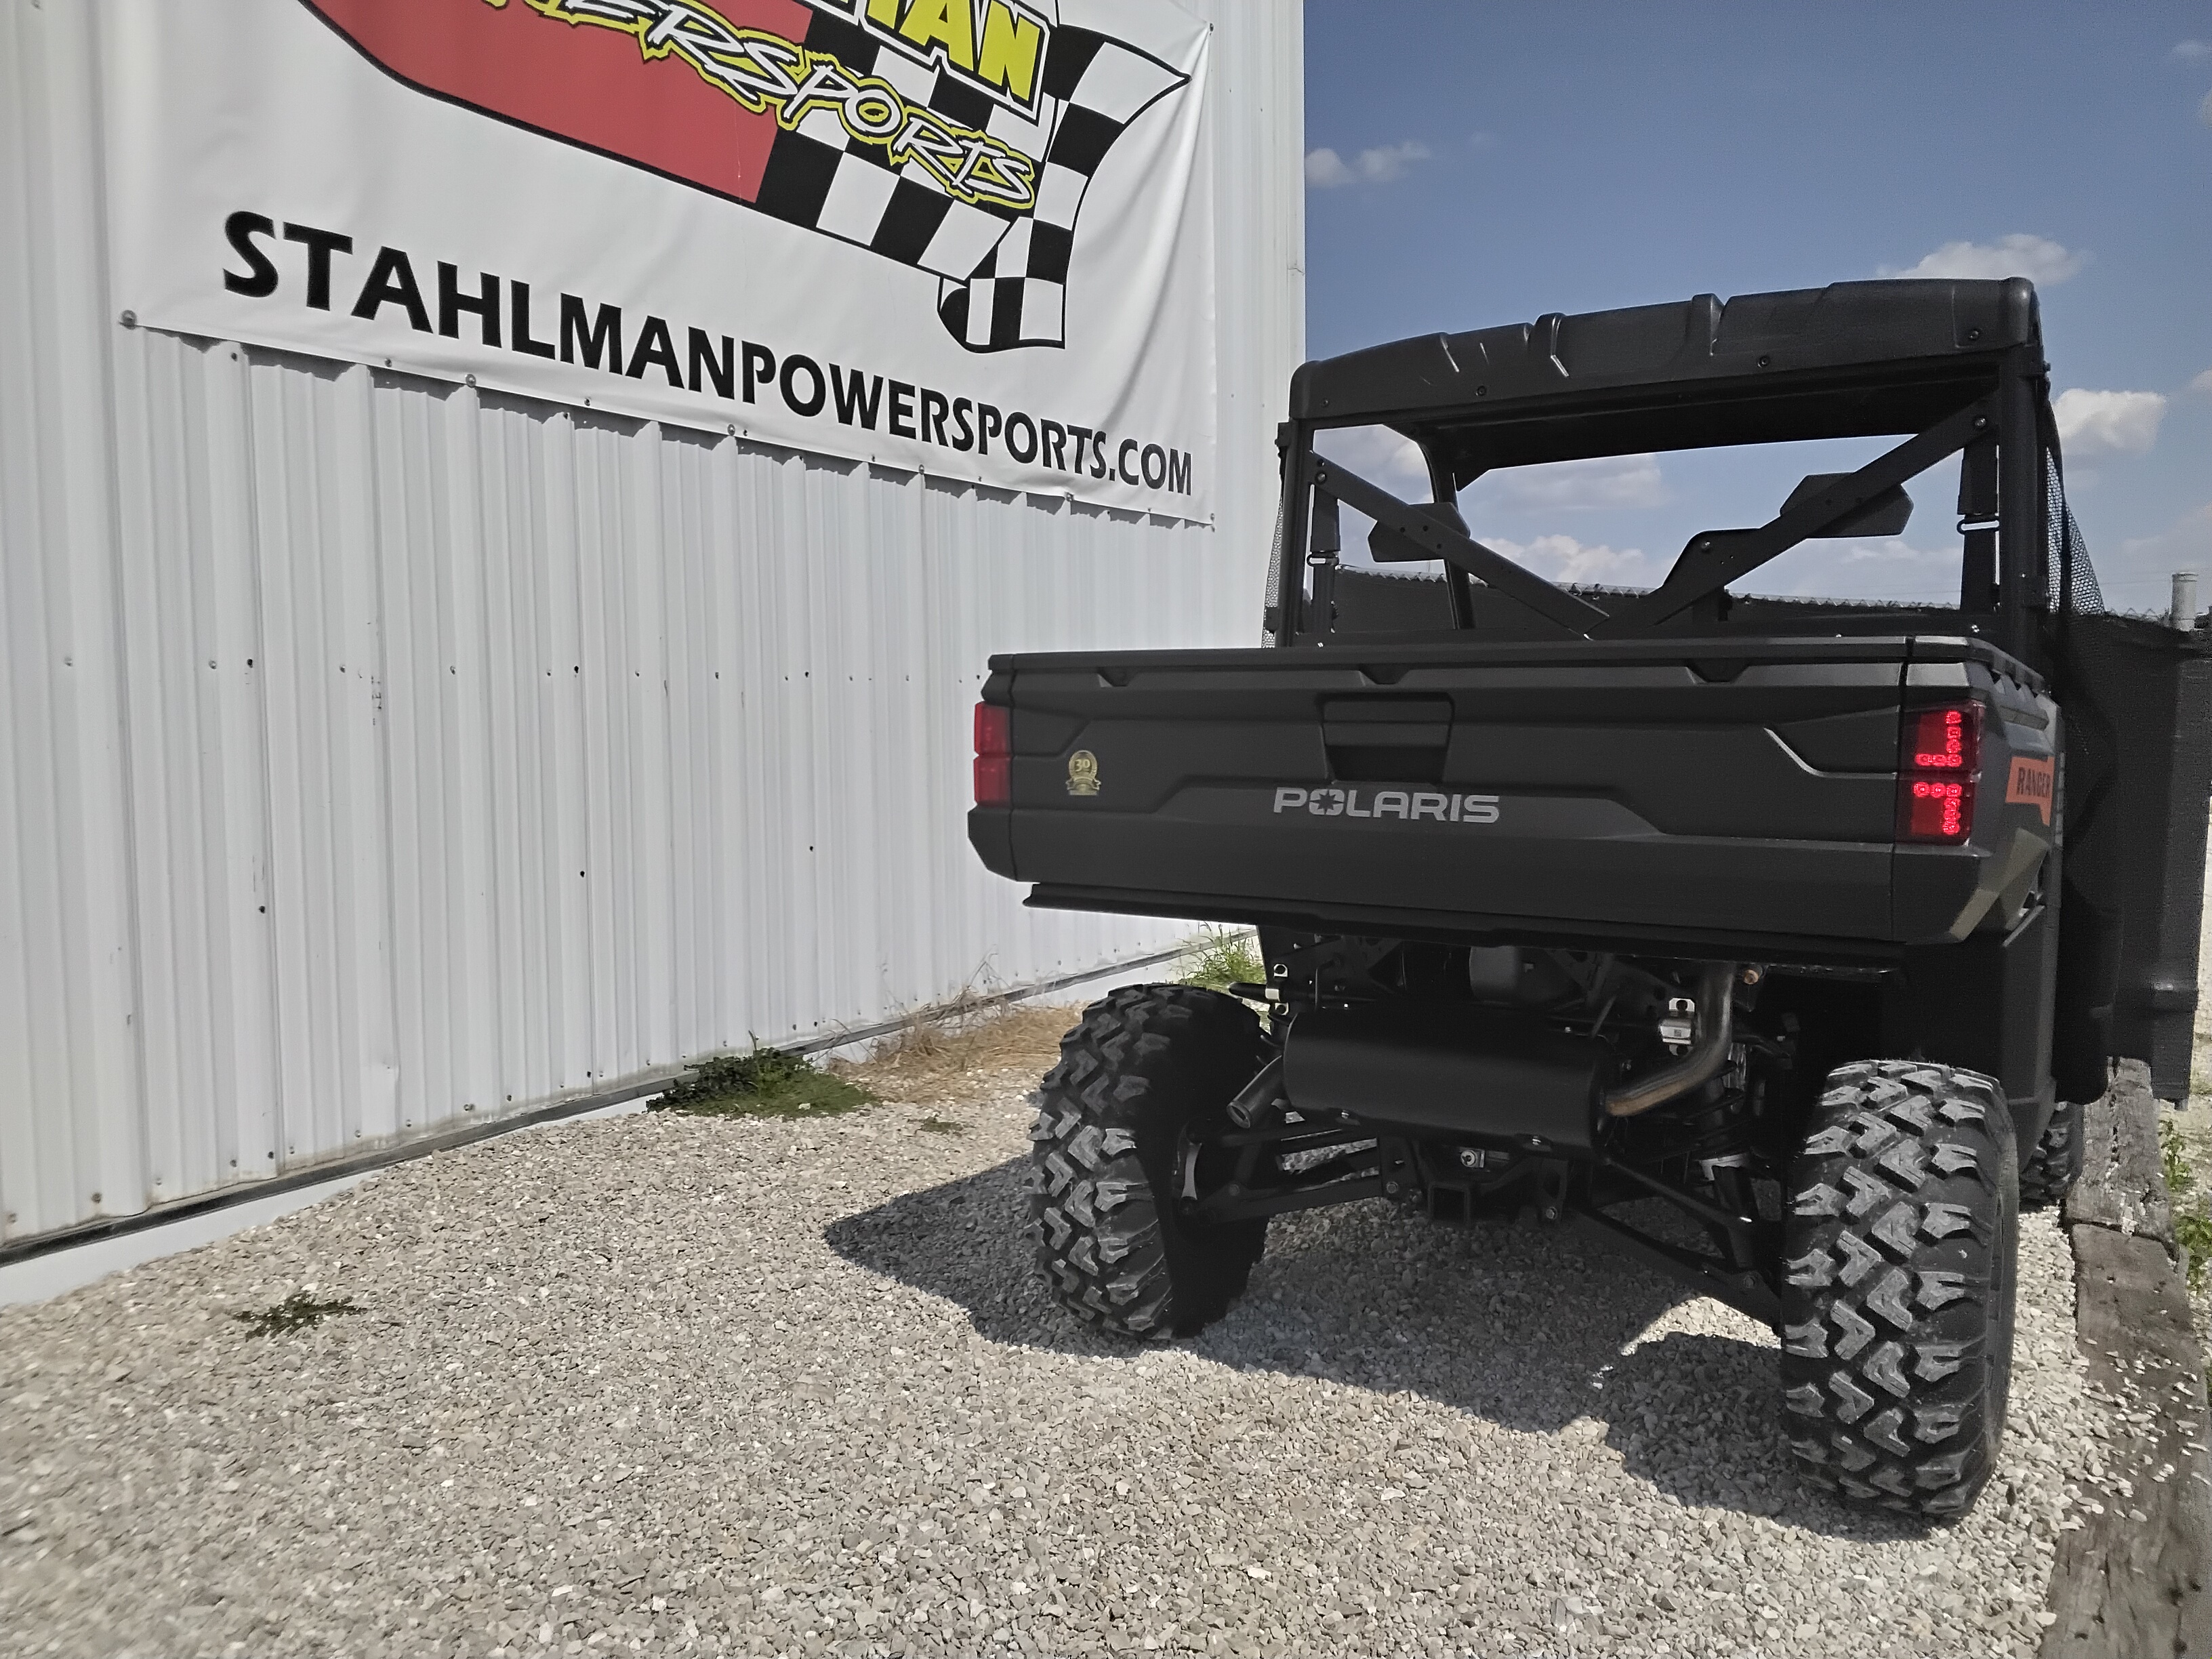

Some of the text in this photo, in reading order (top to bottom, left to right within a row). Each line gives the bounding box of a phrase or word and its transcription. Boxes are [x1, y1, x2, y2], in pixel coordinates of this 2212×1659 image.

[222, 211, 1192, 496] STAHLMANPOWERSPORTS.COM
[2016, 766, 2051, 798] RANGER
[1273, 787, 1500, 823] POLARIS
